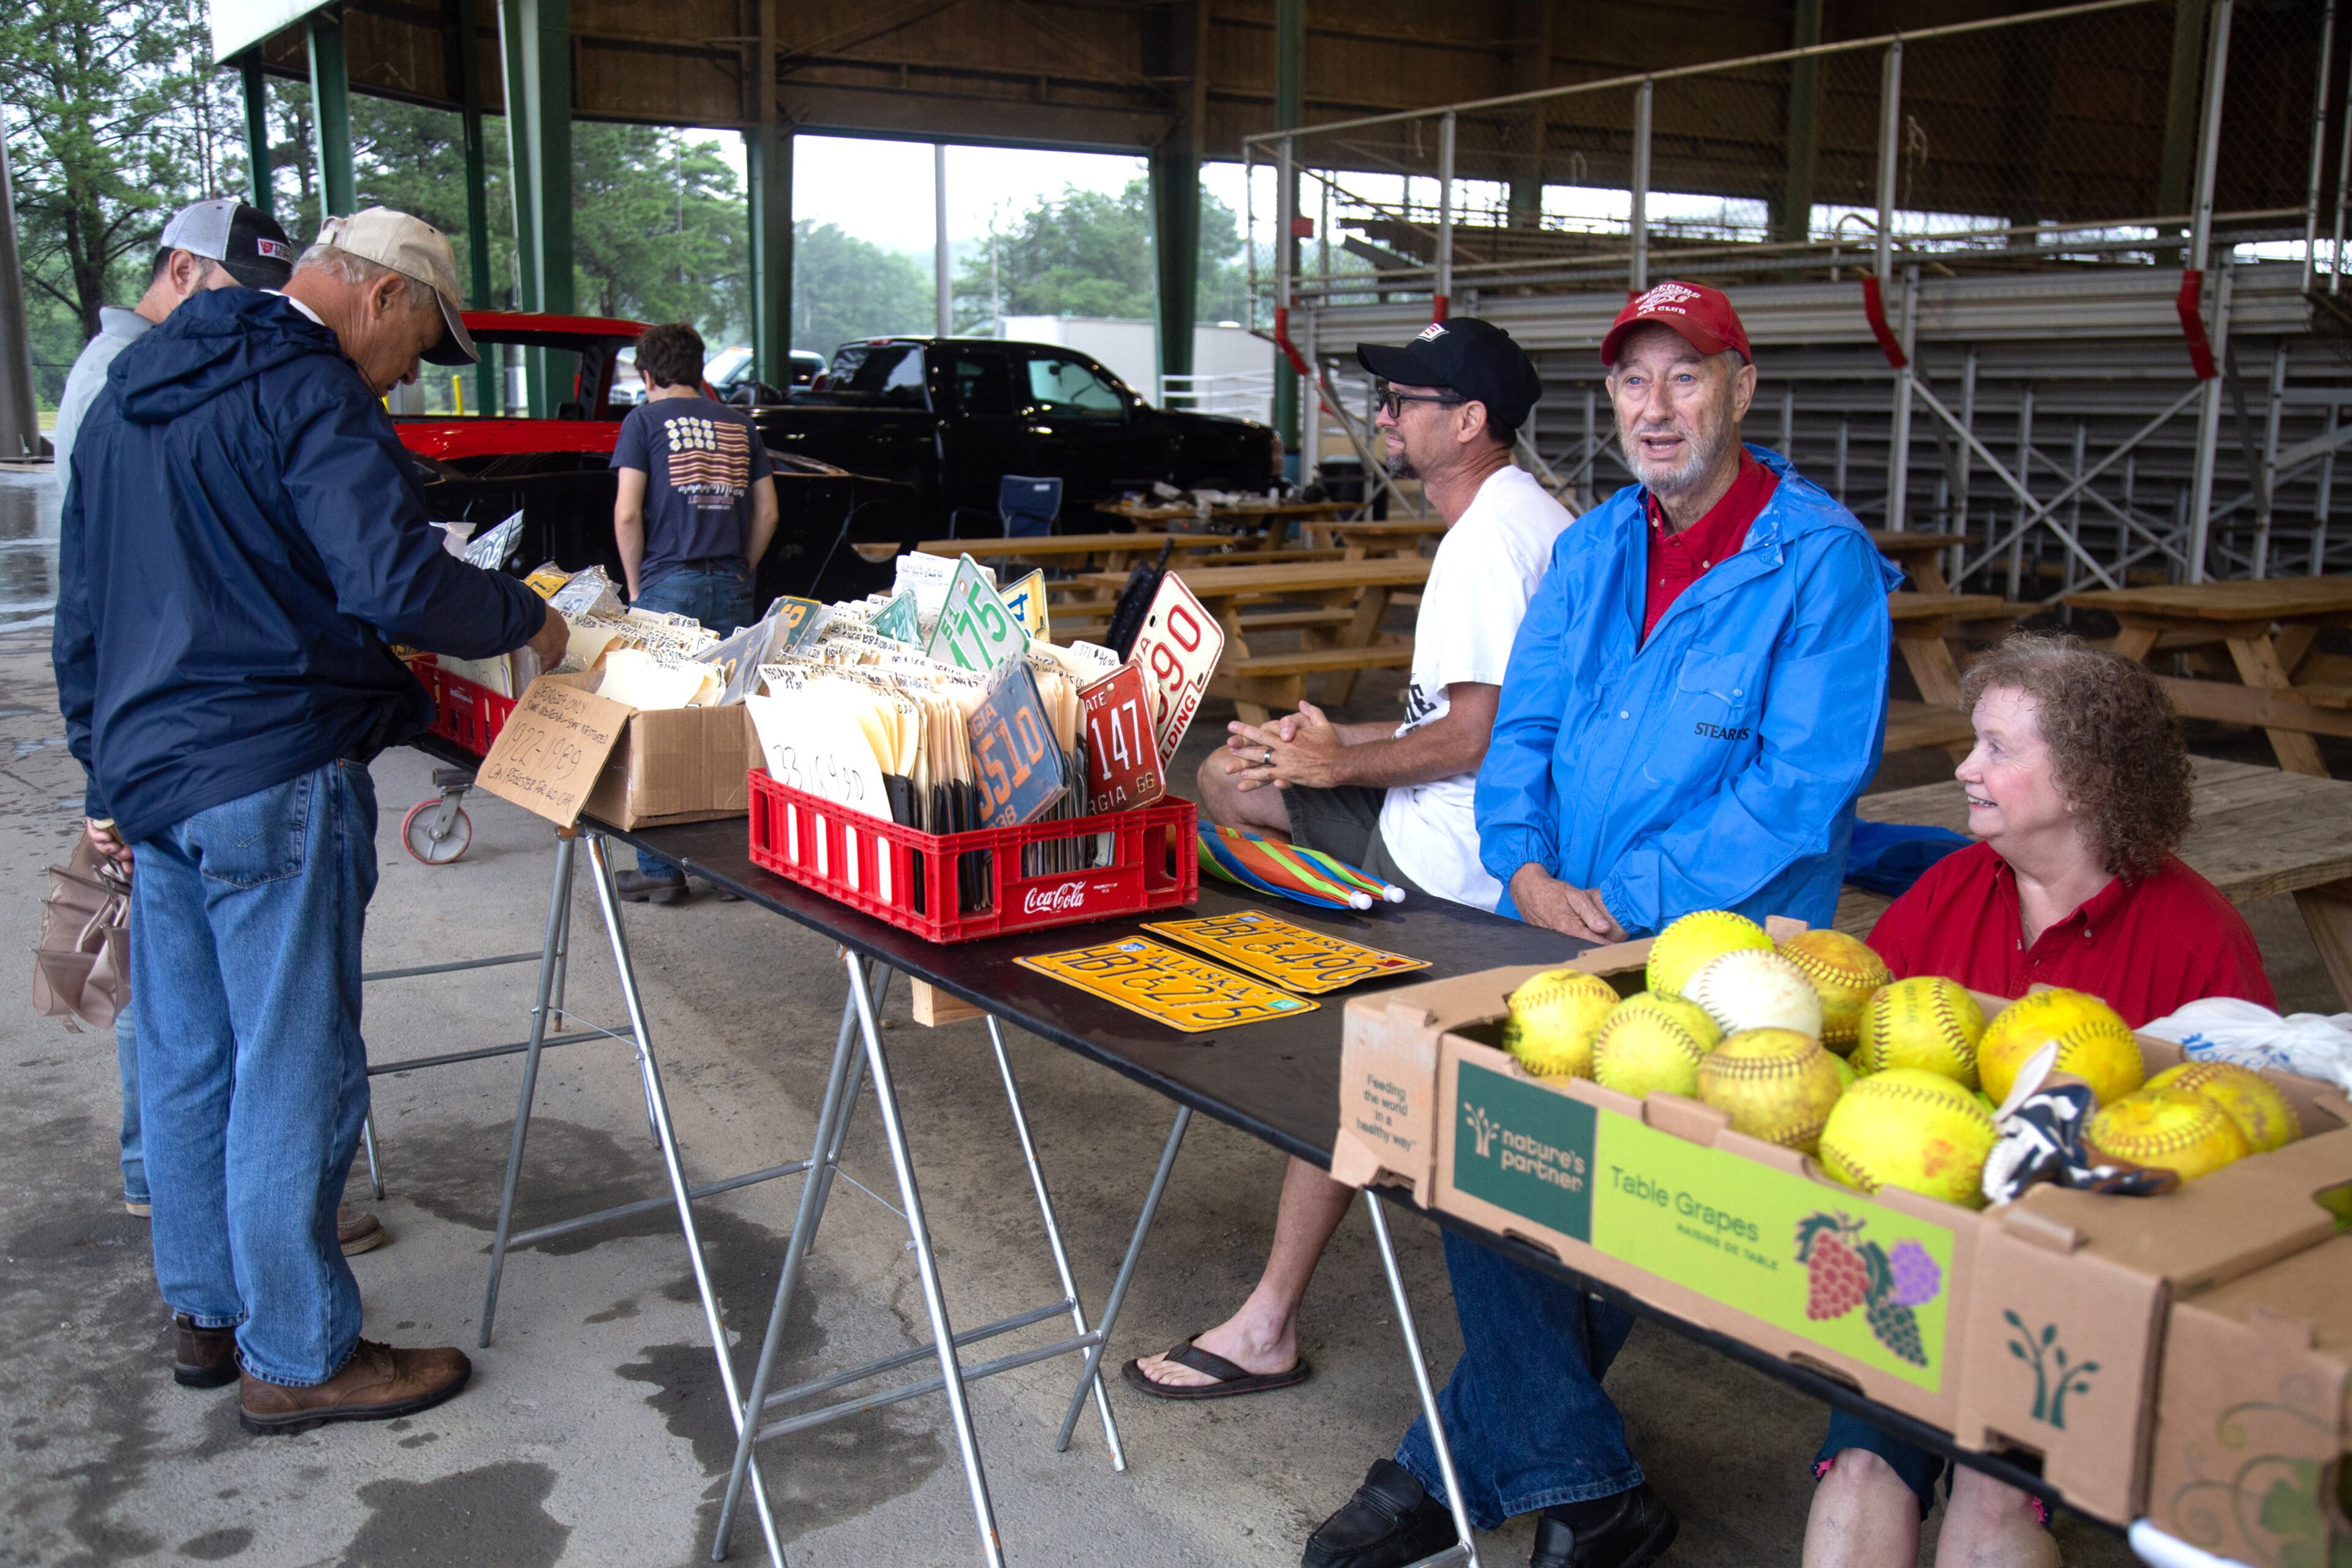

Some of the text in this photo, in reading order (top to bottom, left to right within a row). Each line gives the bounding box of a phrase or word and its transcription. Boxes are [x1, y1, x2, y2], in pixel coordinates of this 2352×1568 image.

[1657, 306, 1686, 314] CLUB
[533, 682, 589, 717] GEORGIA ONLY
[1091, 699, 1142, 781] 147
[1136, 771, 1155, 794] 66
[1170, 919, 1379, 981] HBL 490
[1265, 925, 1368, 959] ALASKA
[1047, 946, 1269, 1021] HBT 275
[1147, 954, 1255, 996] ALASKA
[1363, 1090, 1408, 1117] the world
[1367, 1074, 1406, 1102] Feeding
[1356, 1116, 1390, 1144] healthy
[1375, 1109, 1392, 1127] in a
[1502, 1129, 1585, 1174] nature's
[1502, 1148, 1583, 1193] partner
[1611, 1164, 1759, 1242] Table Grapes
[1676, 1223, 1779, 1271] RAISINS DE TABLE
